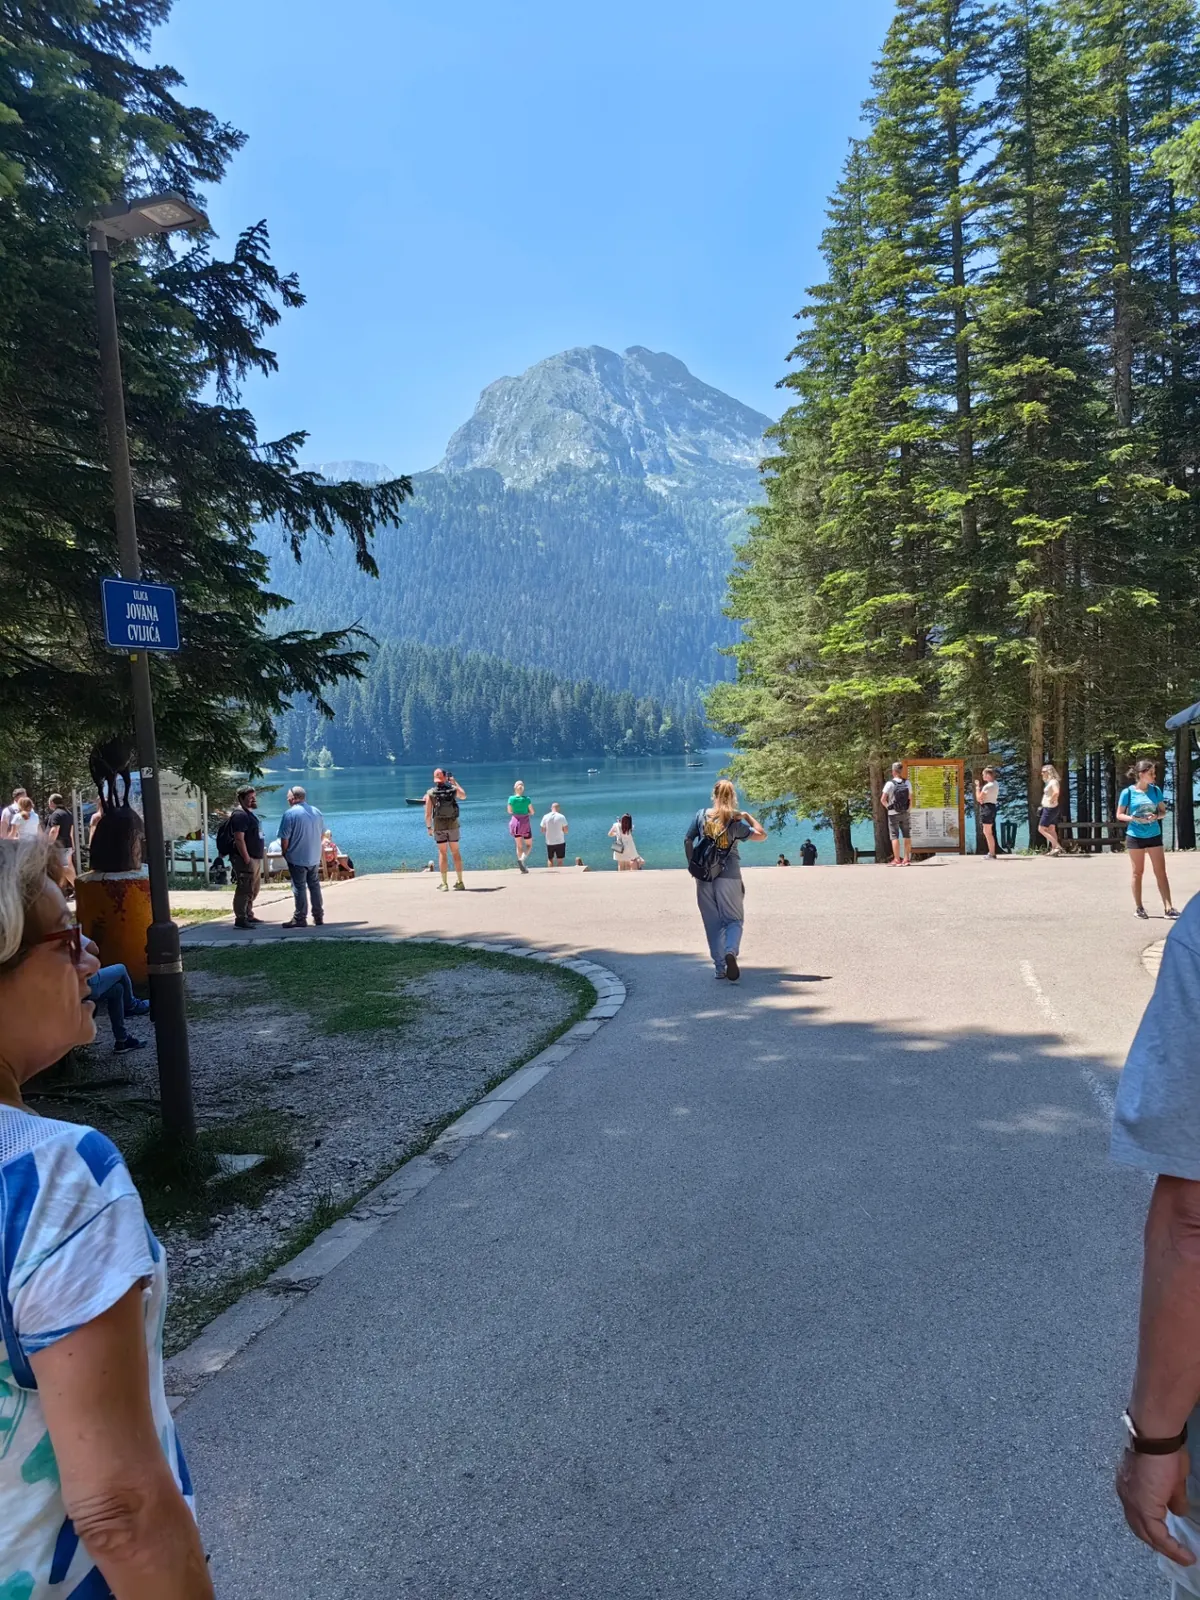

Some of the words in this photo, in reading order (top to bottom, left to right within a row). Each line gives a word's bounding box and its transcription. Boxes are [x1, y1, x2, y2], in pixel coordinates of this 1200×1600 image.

[133, 590, 149, 601] ULICA
[126, 603, 159, 621] JOVANA
[127, 622, 161, 642] CVIJIĆA
